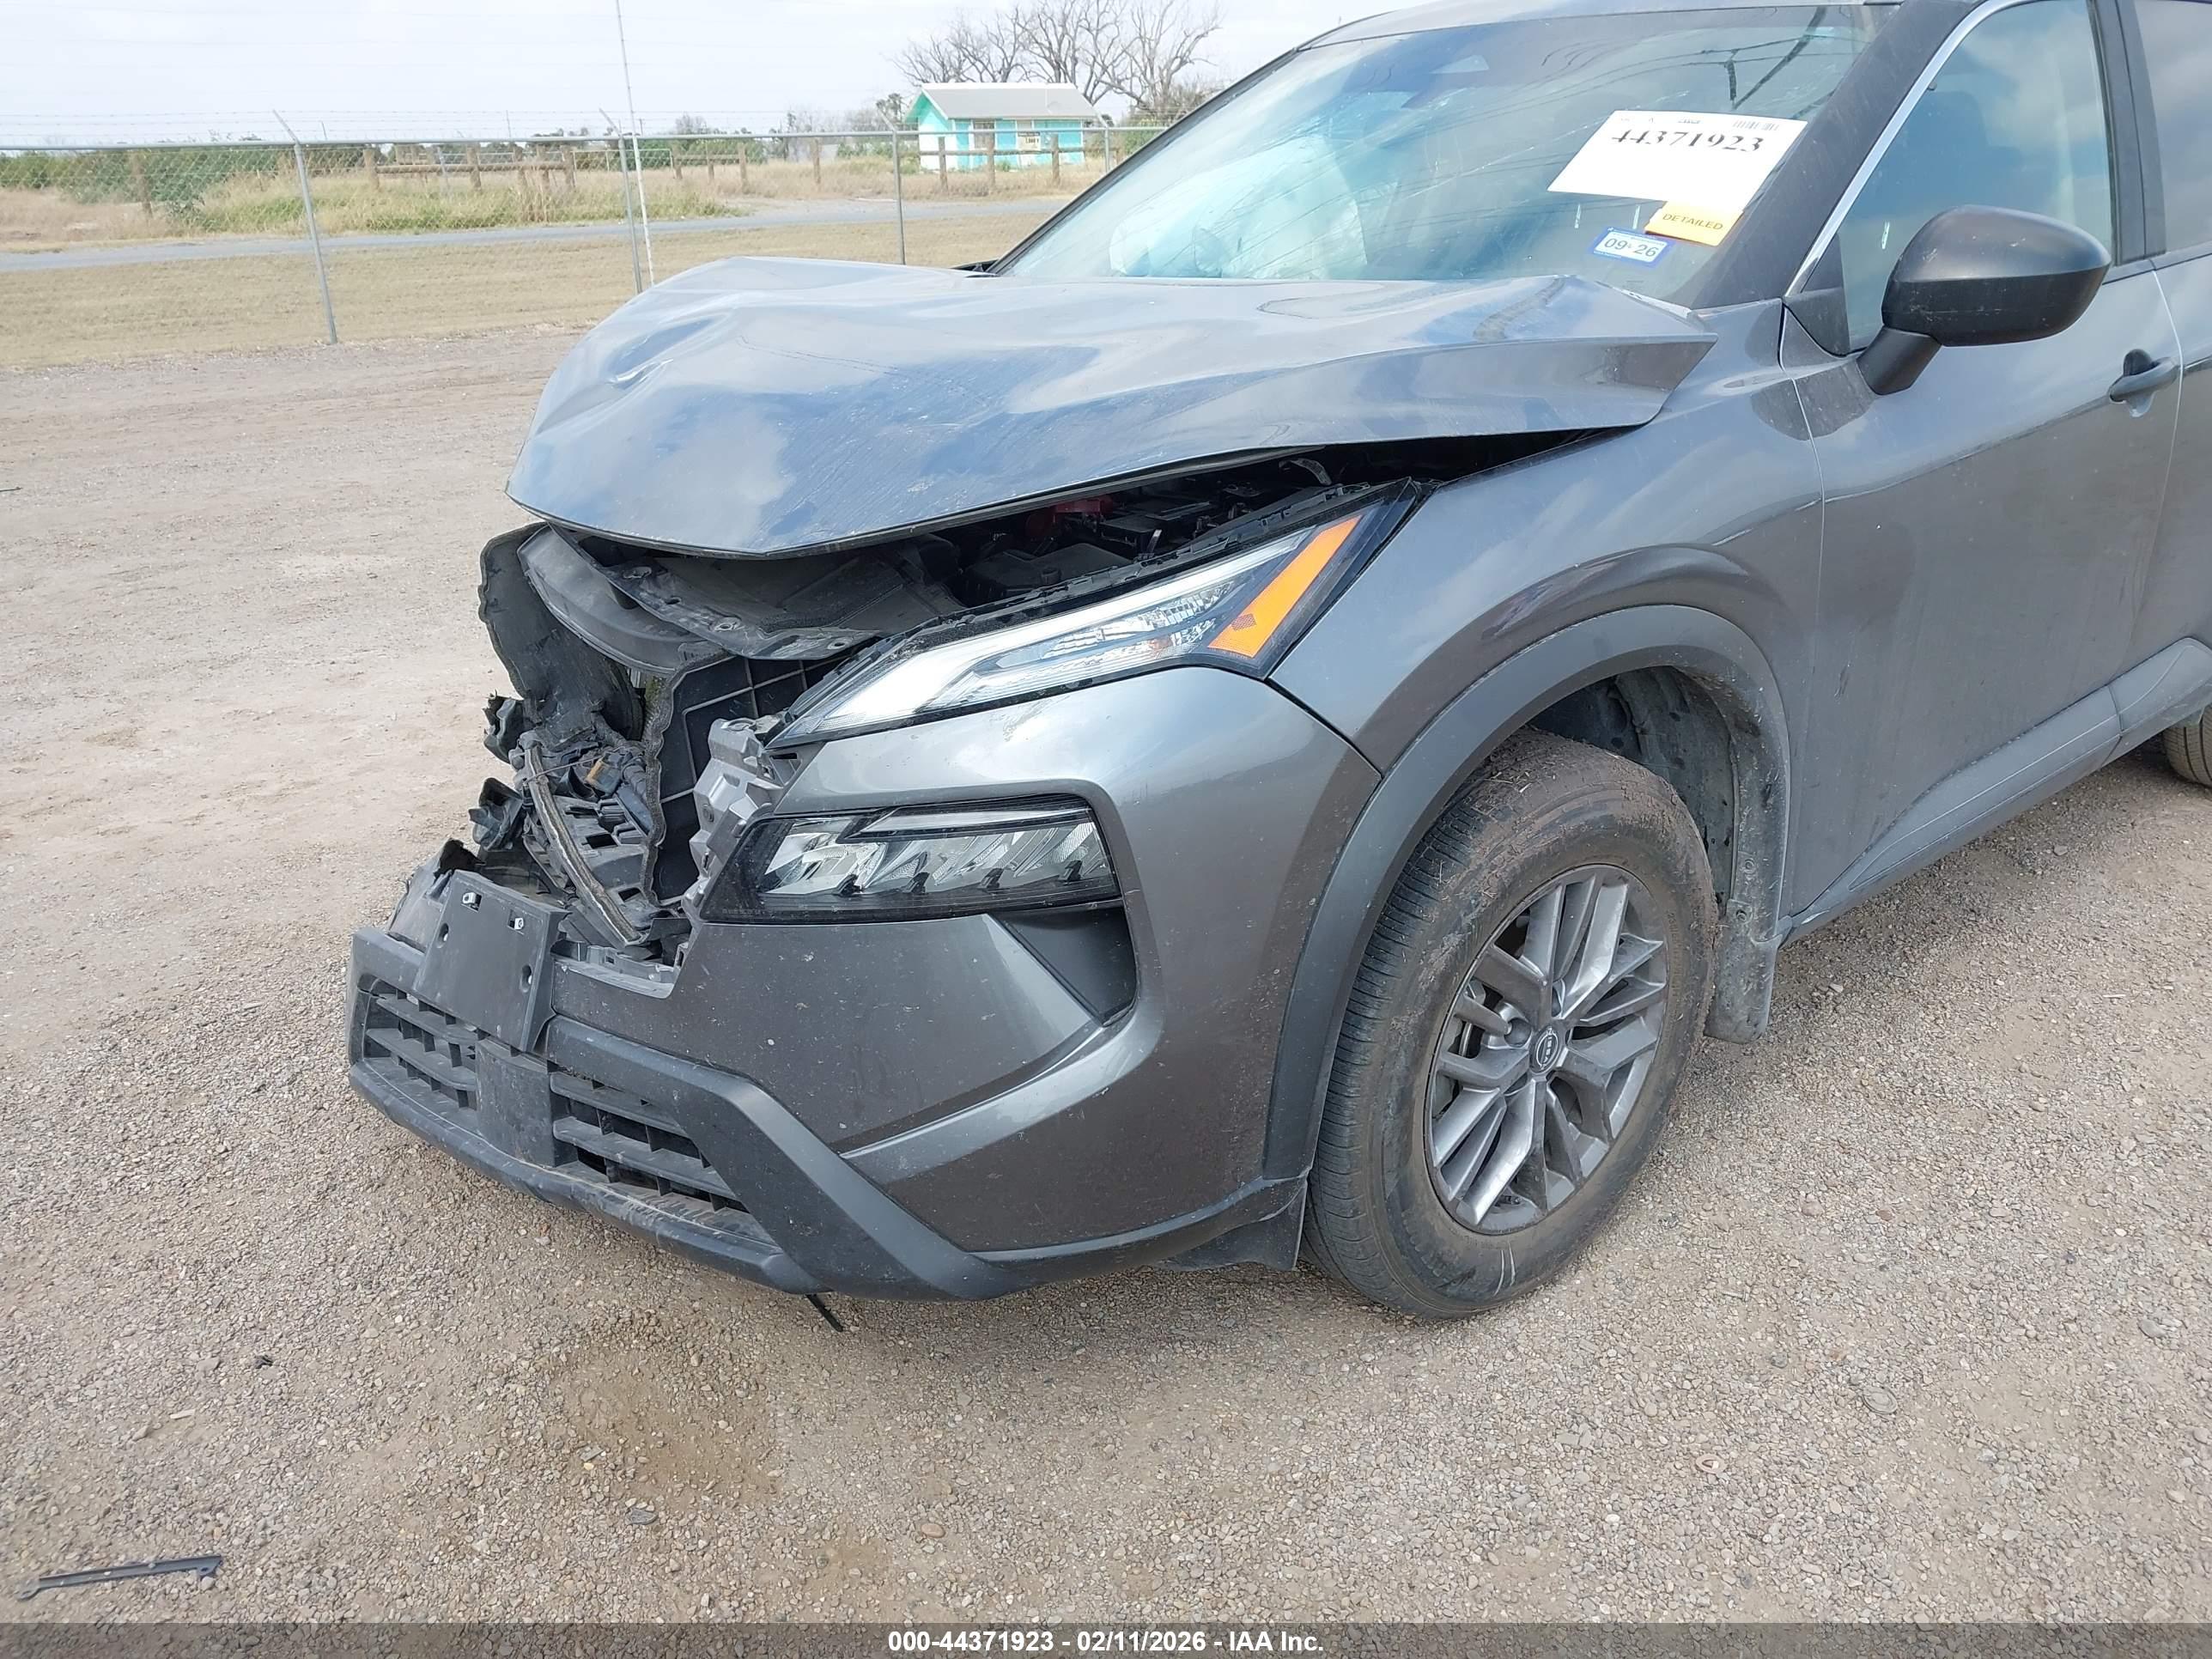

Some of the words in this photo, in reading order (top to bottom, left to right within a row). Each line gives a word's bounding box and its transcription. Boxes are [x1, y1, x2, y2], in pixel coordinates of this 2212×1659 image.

[1611, 129, 1764, 152] 44371923
[1662, 213, 1724, 230] DETAILED
[1604, 238, 1629, 250] 09
[1633, 244, 1659, 258] 26
